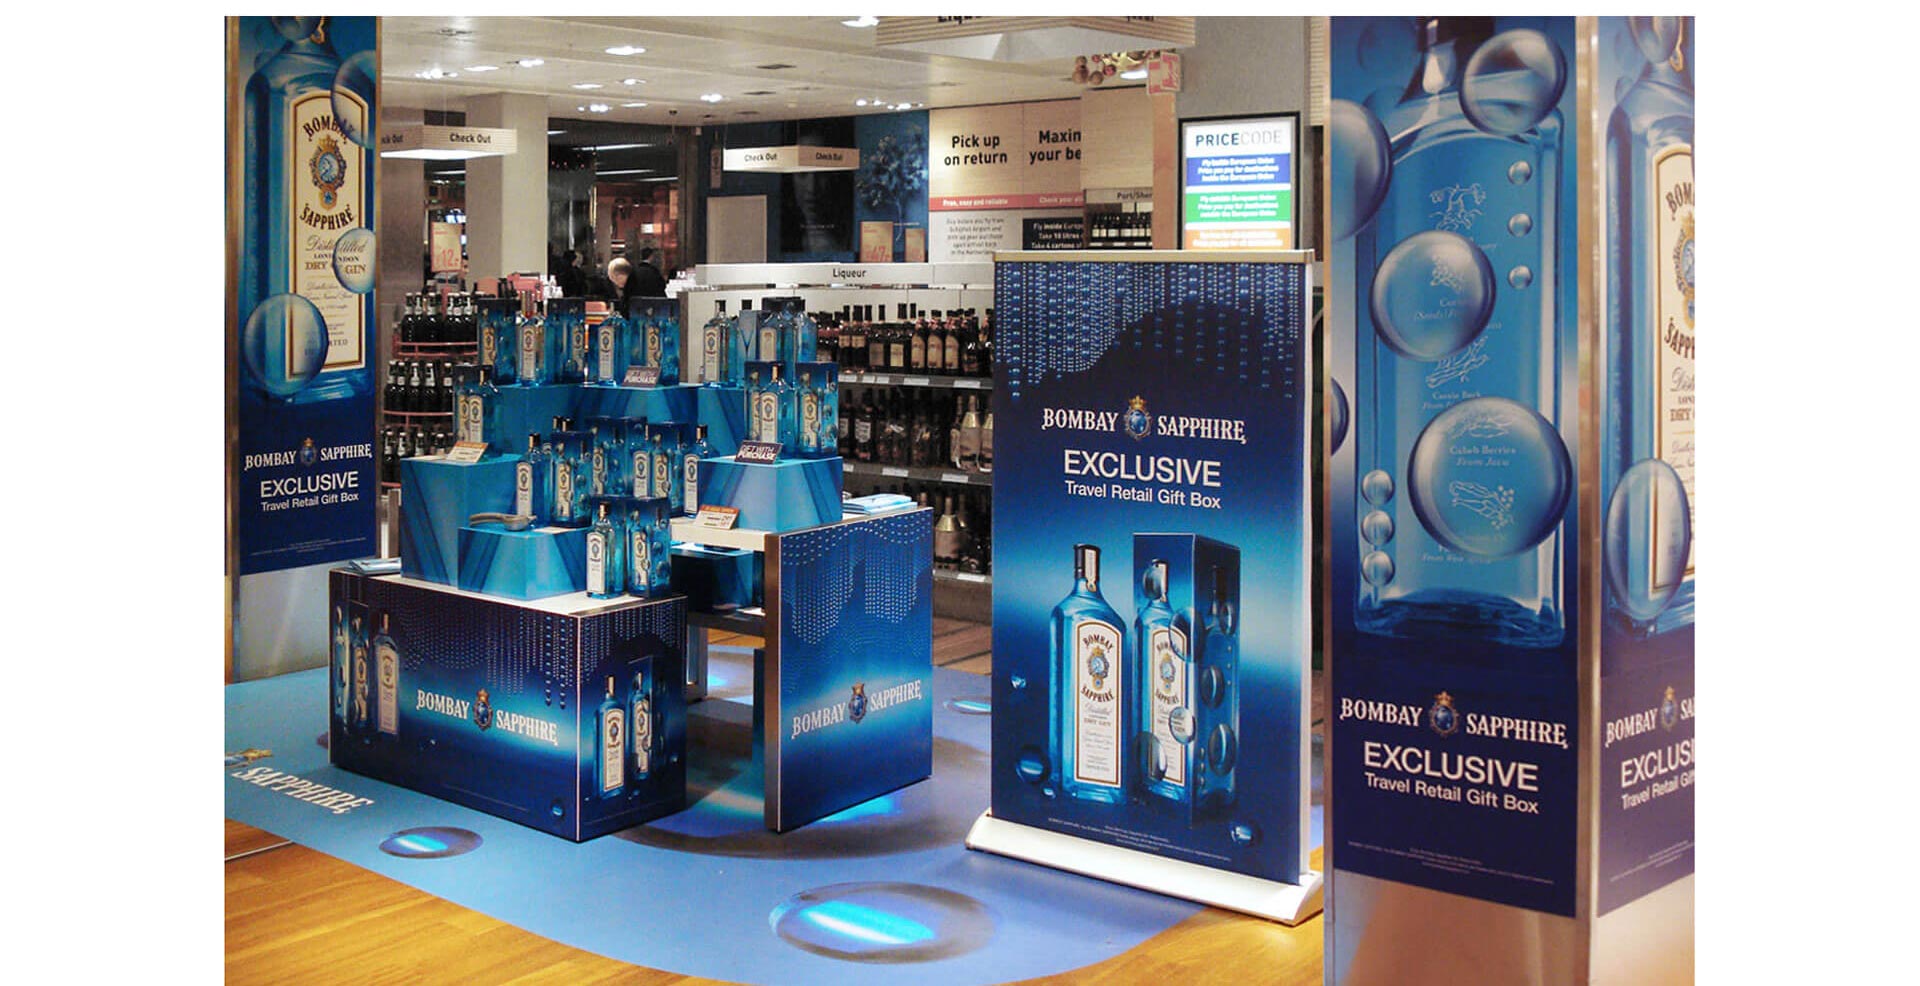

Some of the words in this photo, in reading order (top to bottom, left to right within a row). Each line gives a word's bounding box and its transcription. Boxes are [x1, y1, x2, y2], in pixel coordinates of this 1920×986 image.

[450, 134, 475, 143] Check
[477, 134, 492, 143] Out
[952, 134, 979, 148] Pick
[983, 135, 1000, 149] up
[744, 153, 764, 162] Check
[944, 156, 960, 166] on
[964, 152, 1007, 165] return
[1029, 149, 1062, 165] your
[300, 203, 356, 231] SAPPHIRE
[833, 268, 867, 279] Liqueur
[1041, 407, 1119, 432] BOMBAY
[1157, 415, 1248, 444] SAPPHIRE
[244, 451, 296, 471] BOMBAY
[320, 443, 373, 461] SAPPHIRE
[1064, 449, 1222, 487] EXCLUSIVE
[260, 471, 359, 498] EXCLUSIVE
[1064, 480, 1107, 498] Travel
[1111, 484, 1153, 503] Retail
[1157, 488, 1186, 506] Gift
[1190, 491, 1222, 509] Box
[260, 501, 289, 512] Travel
[292, 495, 319, 508] Retail
[321, 493, 338, 505] Gift
[340, 492, 359, 502] Box
[1082, 633, 1114, 653] BOMBAY
[1080, 683, 1115, 703] SAPPHIRE
[416, 689, 470, 720] BOMBAY
[496, 709, 559, 747] SAPPHIRE
[791, 702, 846, 740] BOMBAY
[870, 679, 922, 712] SAPPHIRE
[1339, 697, 1423, 727] BOMBAY
[1466, 712, 1568, 749] SAPPHIRE
[1605, 708, 1658, 748] BOMBAY
[1364, 741, 1539, 792] EXCLUSIVE
[231, 766, 375, 815] SAPPHIRE
[1364, 772, 1410, 794] Travel
[1415, 779, 1461, 802] Retail
[1466, 788, 1498, 809] Gift
[1503, 794, 1539, 814] Box
[1621, 787, 1650, 811] Travel
[1651, 775, 1679, 799] Retail
